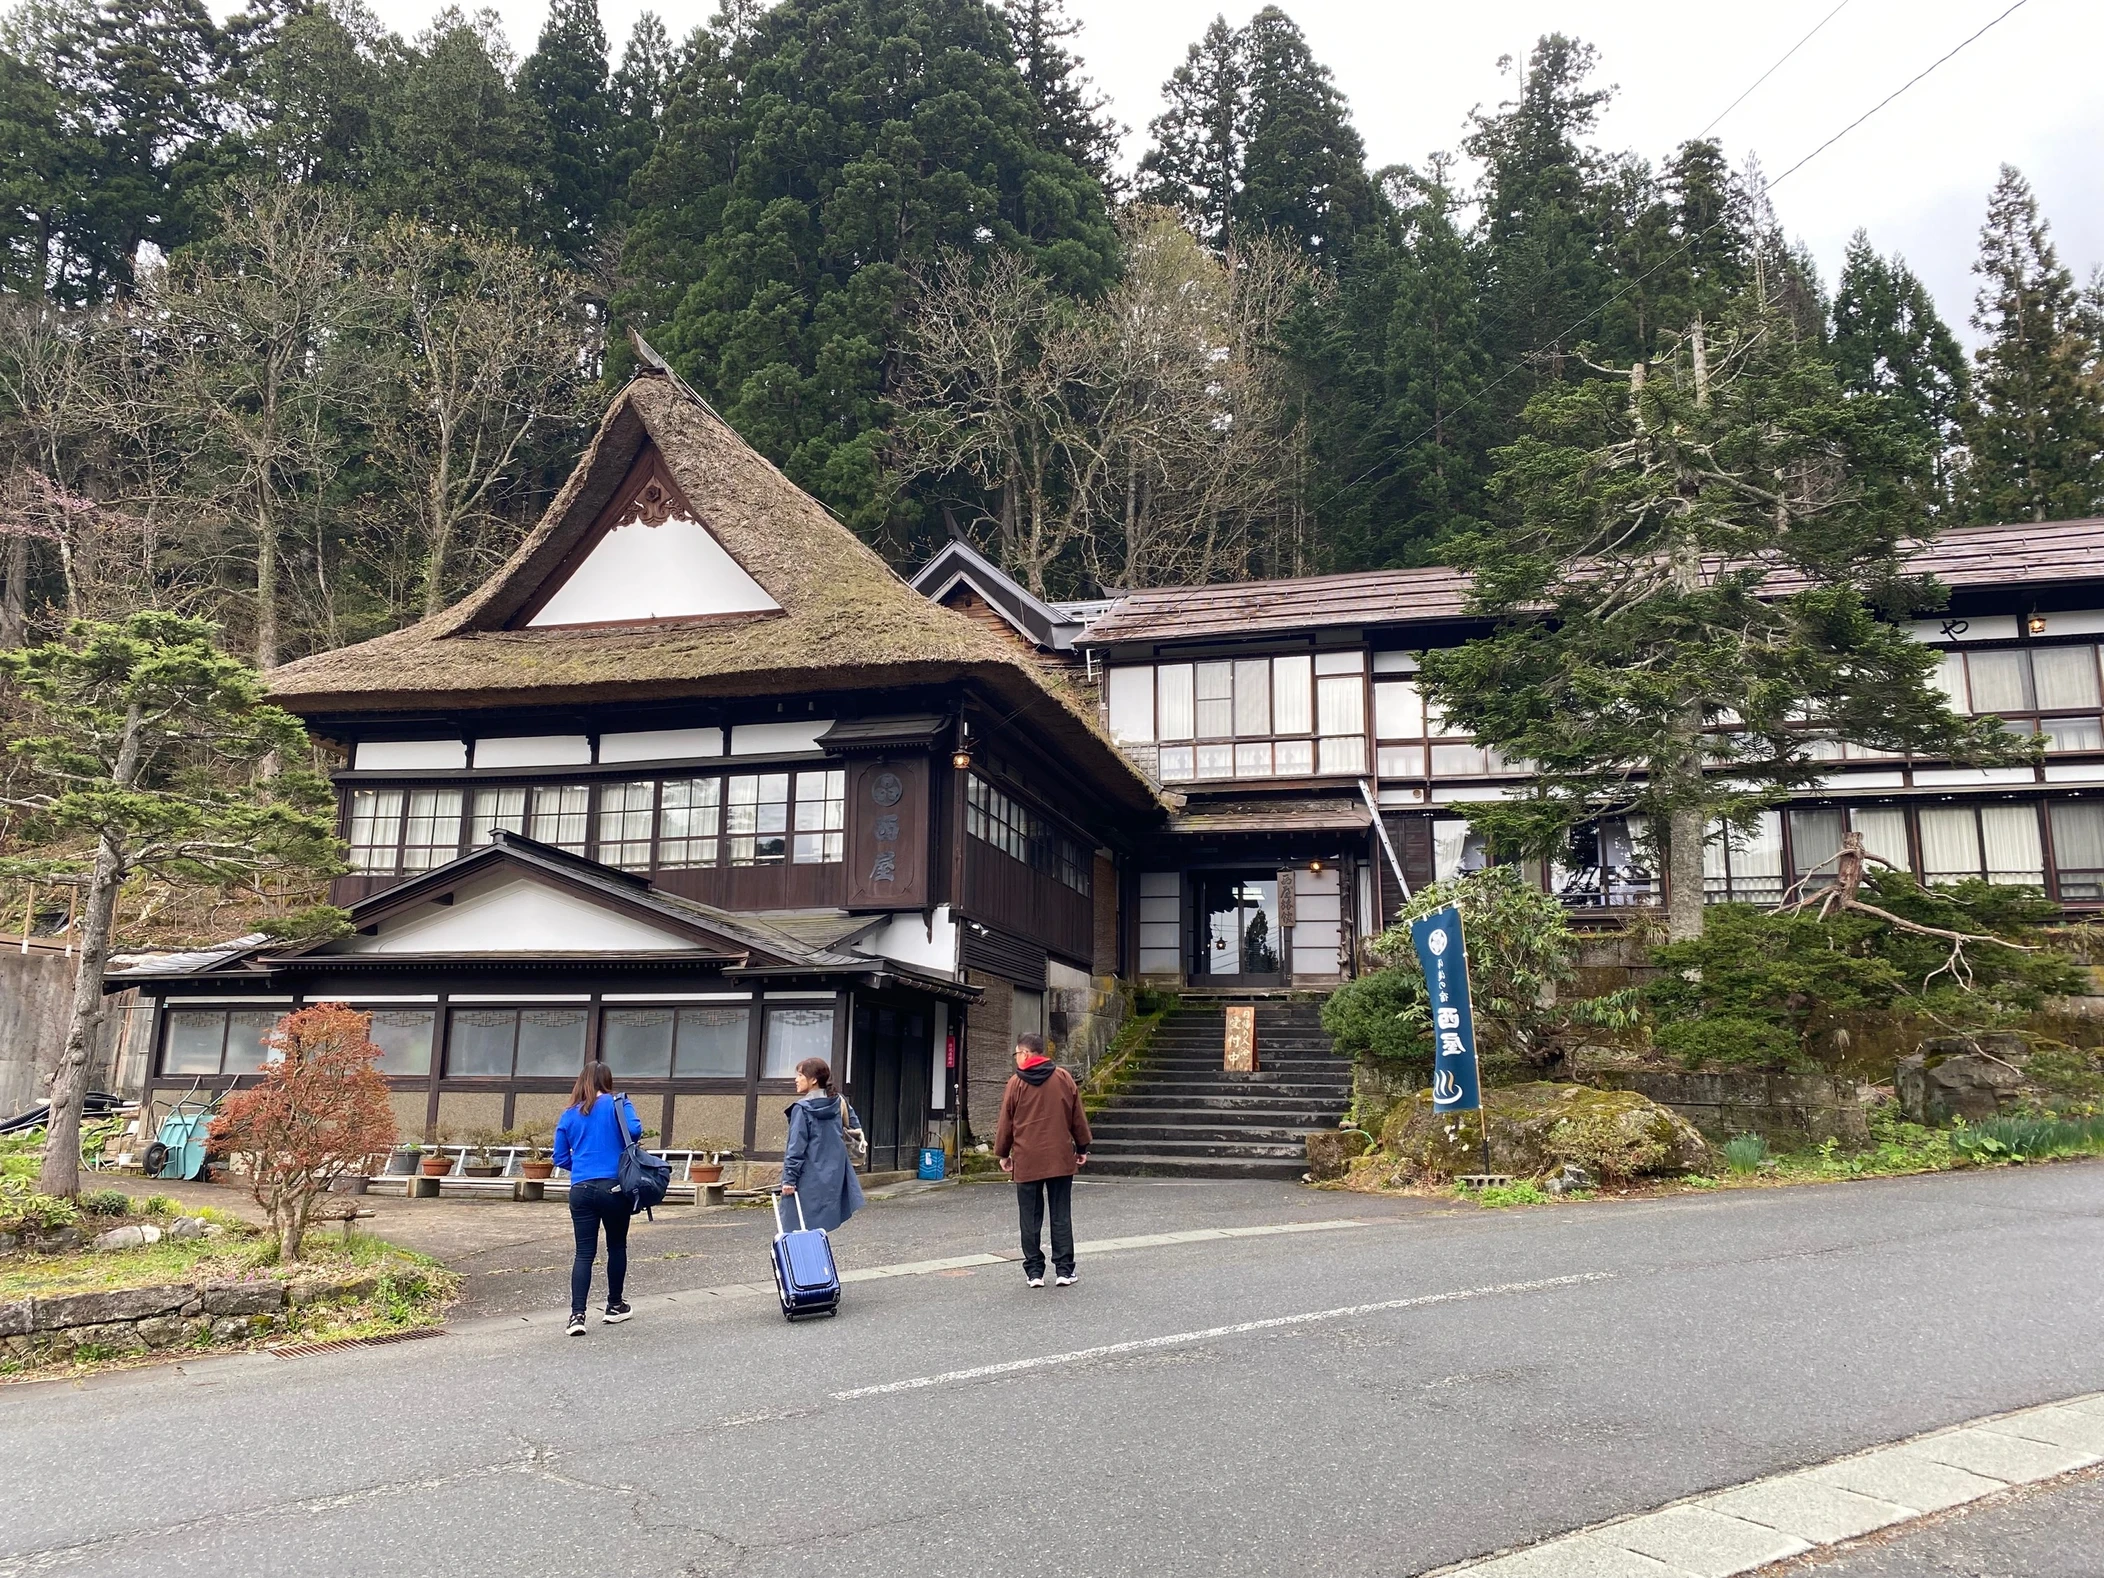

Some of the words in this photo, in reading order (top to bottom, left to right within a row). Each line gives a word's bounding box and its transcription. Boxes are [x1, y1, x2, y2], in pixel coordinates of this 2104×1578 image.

[1939, 619, 1969, 641] や
[869, 813, 900, 882] 西屋
[1228, 1016, 1242, 1066] 受付中
[1240, 1010, 1251, 1057] 日帰り入浴
